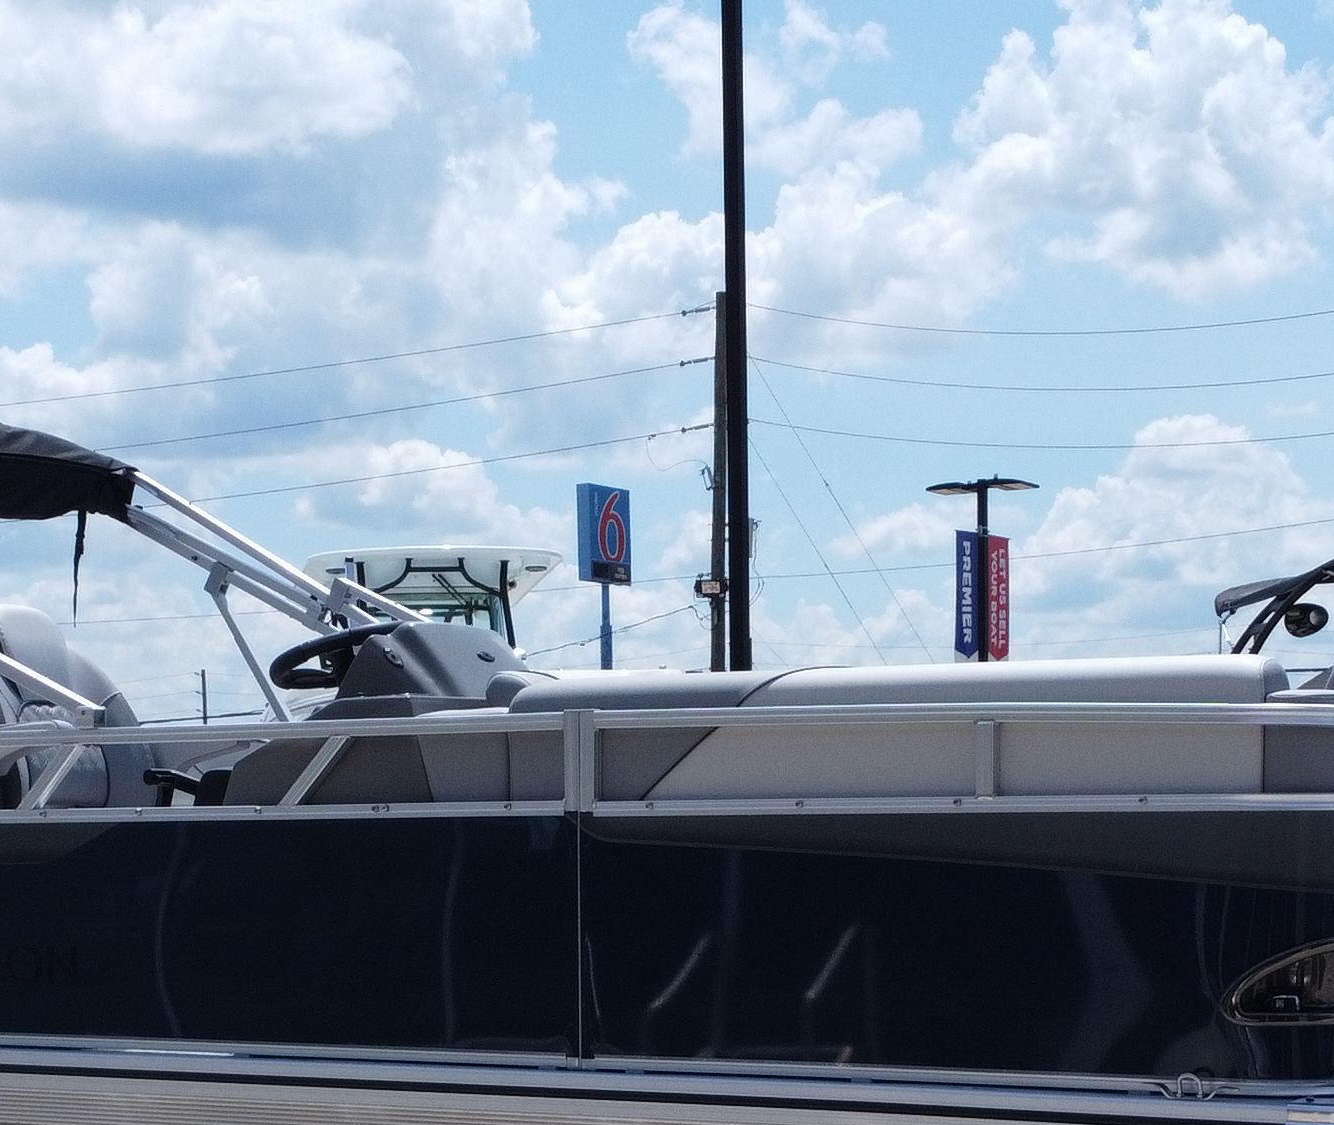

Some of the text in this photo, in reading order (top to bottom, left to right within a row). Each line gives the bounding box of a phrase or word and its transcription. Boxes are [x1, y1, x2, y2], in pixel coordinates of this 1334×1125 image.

[598, 491, 626, 563] 6
[962, 541, 973, 644] PREMIER
[999, 584, 1006, 605] US
